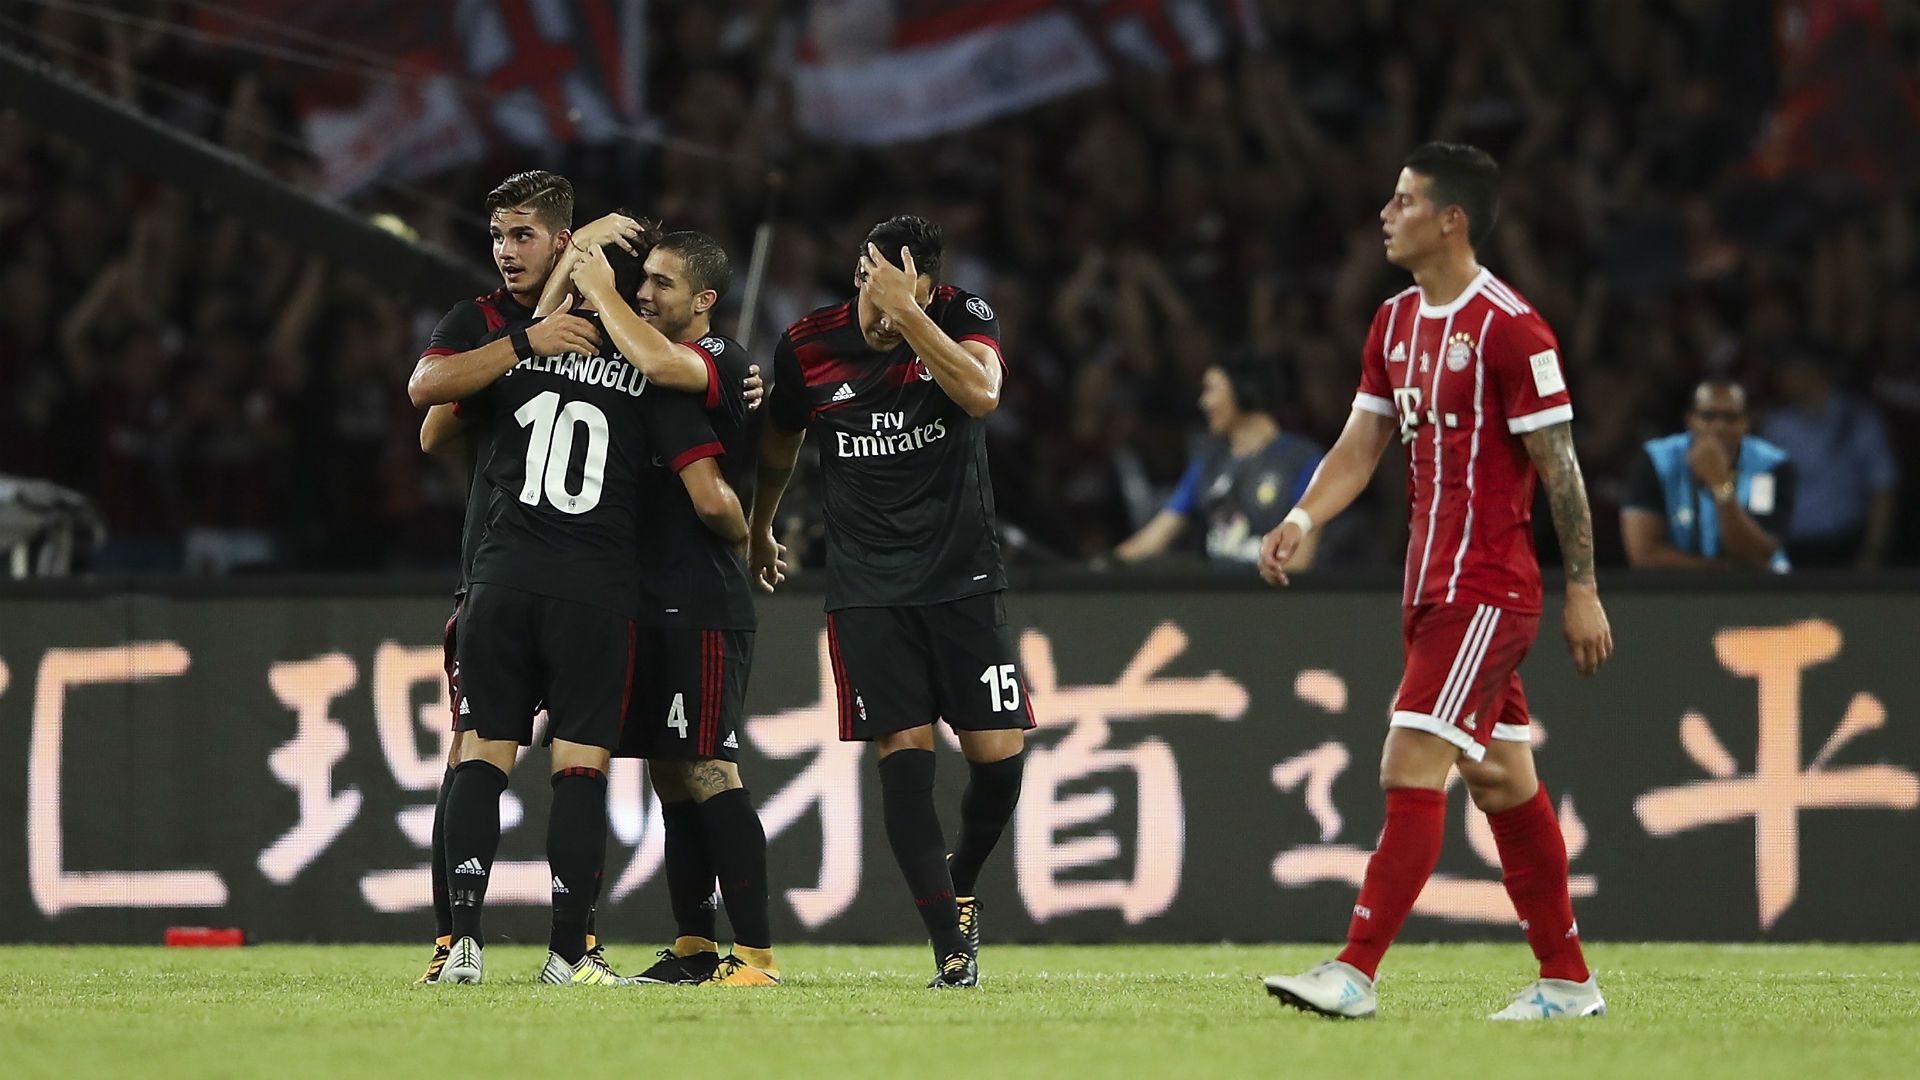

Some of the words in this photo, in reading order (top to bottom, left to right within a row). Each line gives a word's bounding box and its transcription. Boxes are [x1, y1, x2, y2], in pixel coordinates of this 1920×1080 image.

[505, 351, 648, 397] ALHANOĞLU
[836, 418, 946, 458] Emirates
[871, 411, 904, 430] Fly
[514, 390, 610, 515] 10
[980, 664, 1020, 712] 15
[667, 692, 688, 739] 4
